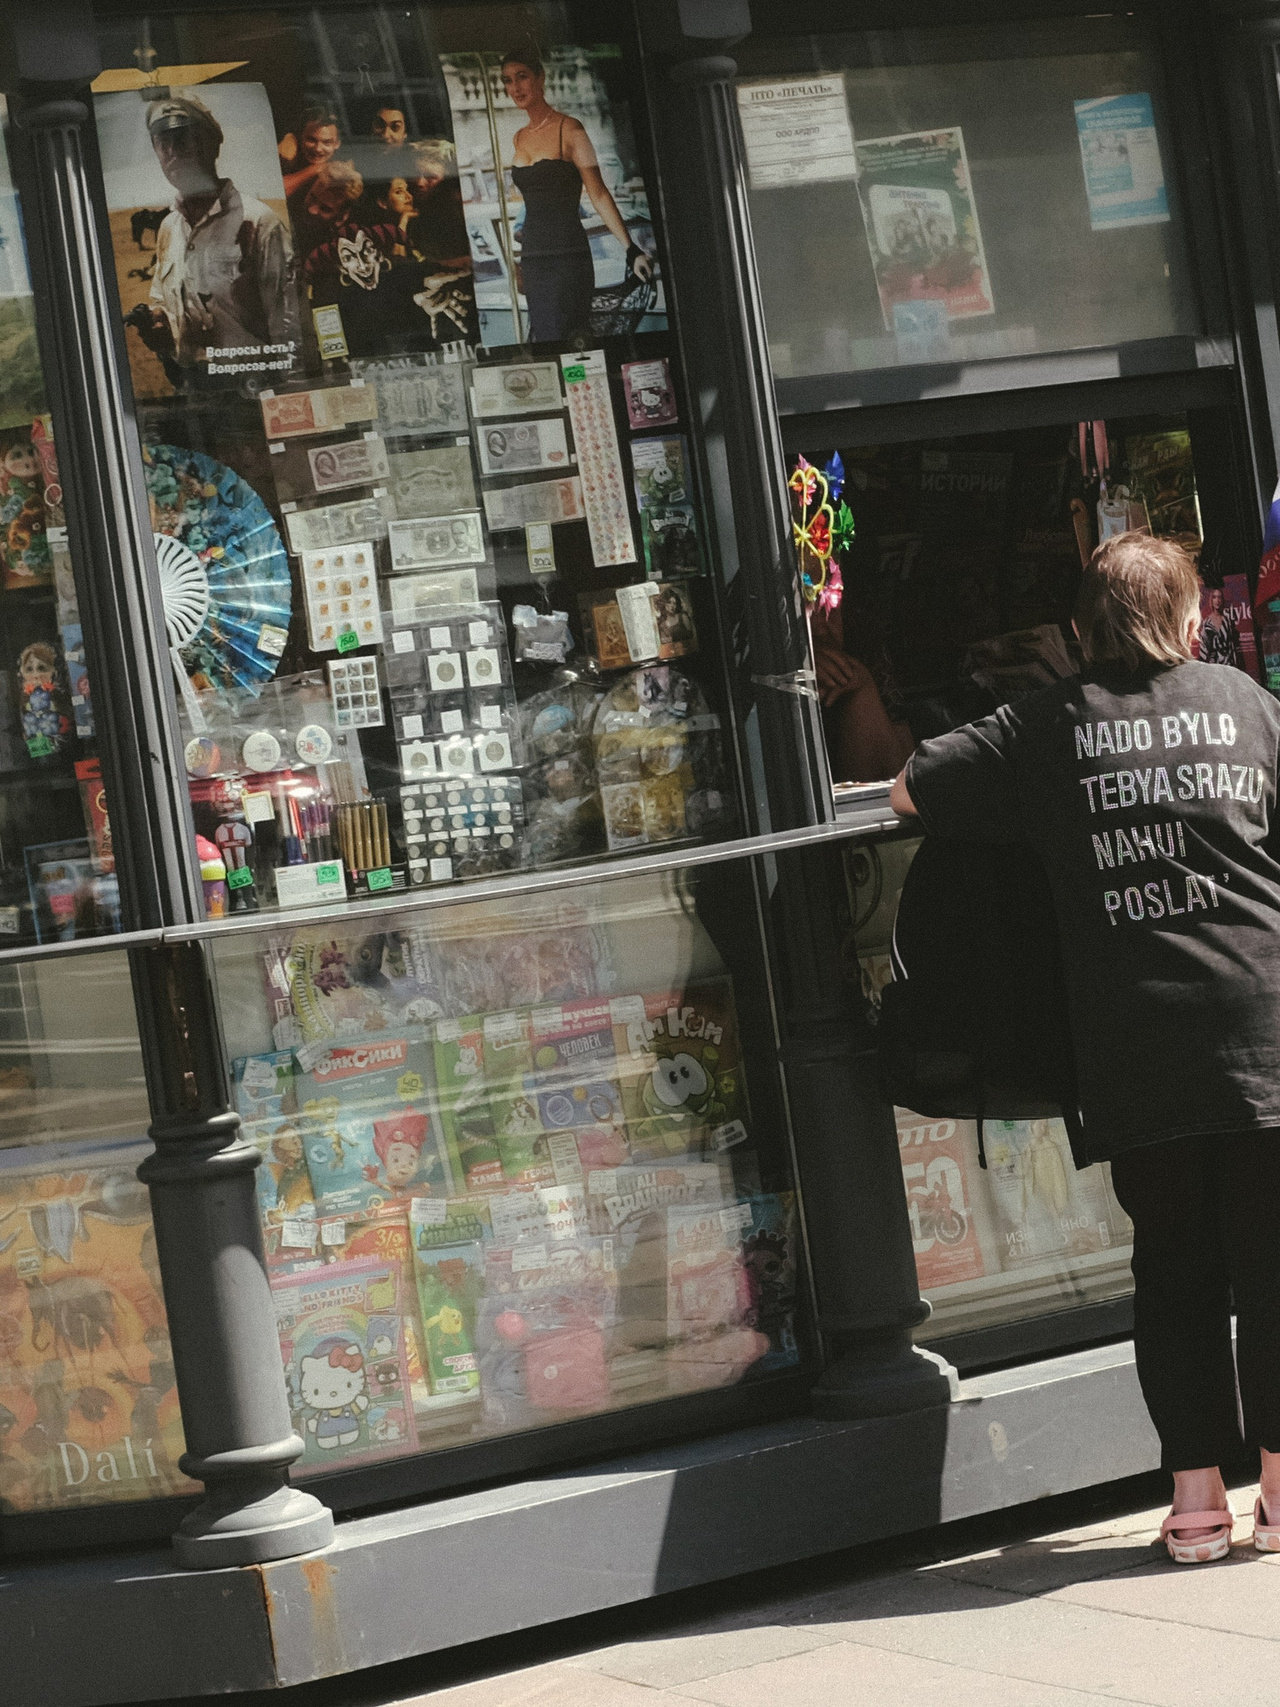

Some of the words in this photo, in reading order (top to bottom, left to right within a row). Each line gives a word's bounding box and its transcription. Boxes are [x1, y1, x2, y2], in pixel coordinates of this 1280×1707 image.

[206, 343, 261, 359] Вопросы
[263, 340, 295, 354] есть?
[1074, 718, 1151, 759] NADO
[1161, 711, 1237, 749] BYLO
[1080, 766, 1175, 813] TEBYA
[1176, 763, 1265, 804] SRAZU
[1091, 821, 1187, 870] NAHUI
[58, 1437, 160, 1487] Dalí
